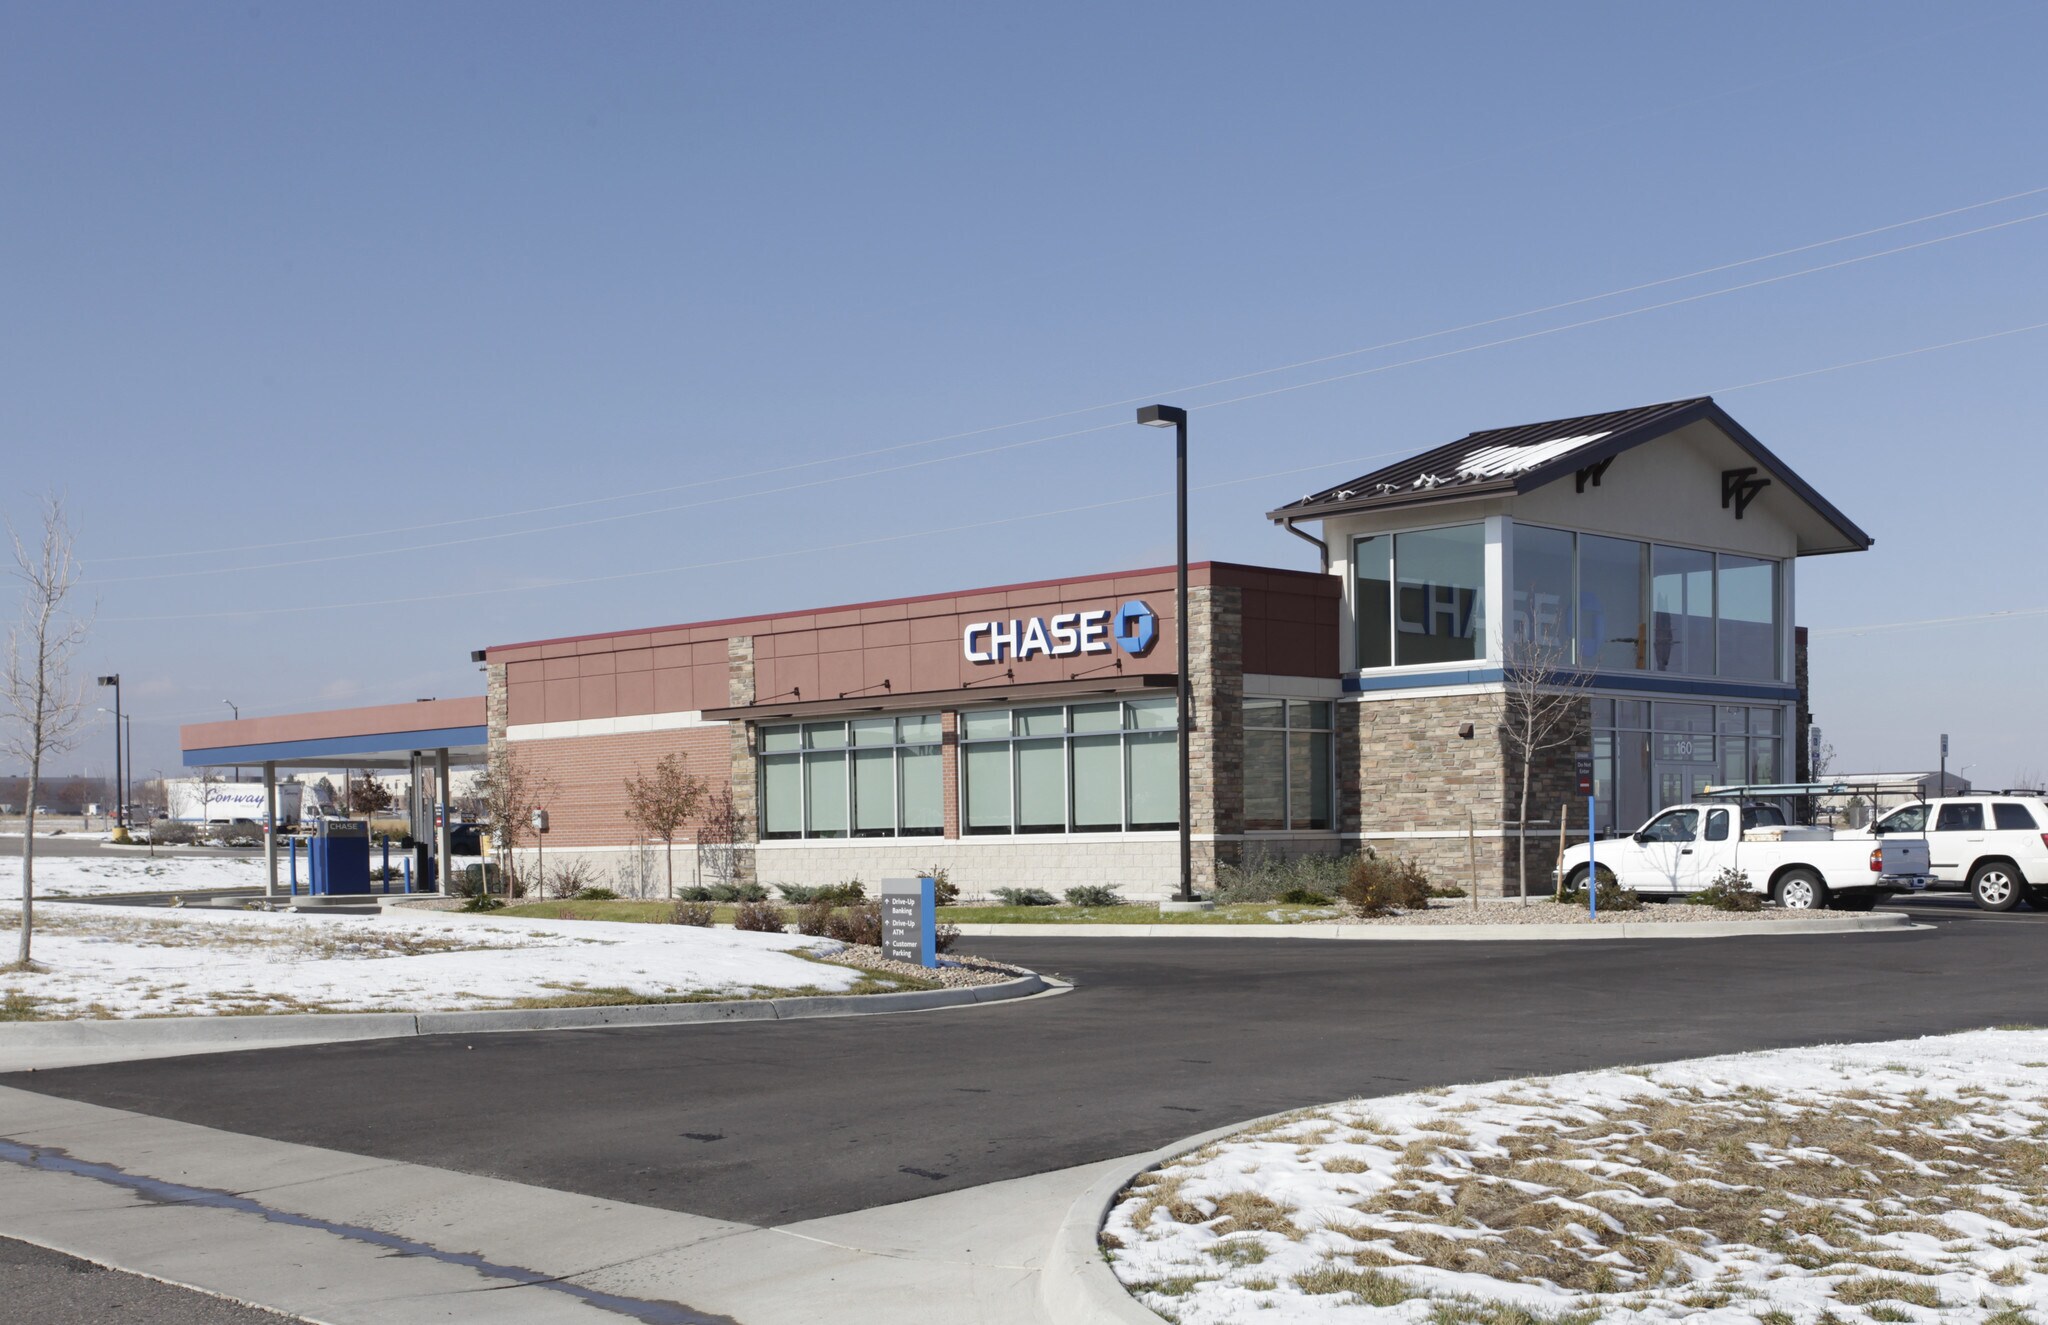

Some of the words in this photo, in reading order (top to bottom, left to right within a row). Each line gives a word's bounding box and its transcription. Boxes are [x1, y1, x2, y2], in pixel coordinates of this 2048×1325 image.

[964, 610, 1107, 662] CHASE
[1676, 741, 1692, 755] 160
[206, 788, 265, 808] Con-way
[892, 898, 915, 906] Drive-Up
[892, 907, 913, 916] Banking
[892, 920, 916, 928] Drive-Up
[892, 940, 918, 948] Customer
[892, 949, 912, 958] Parking
